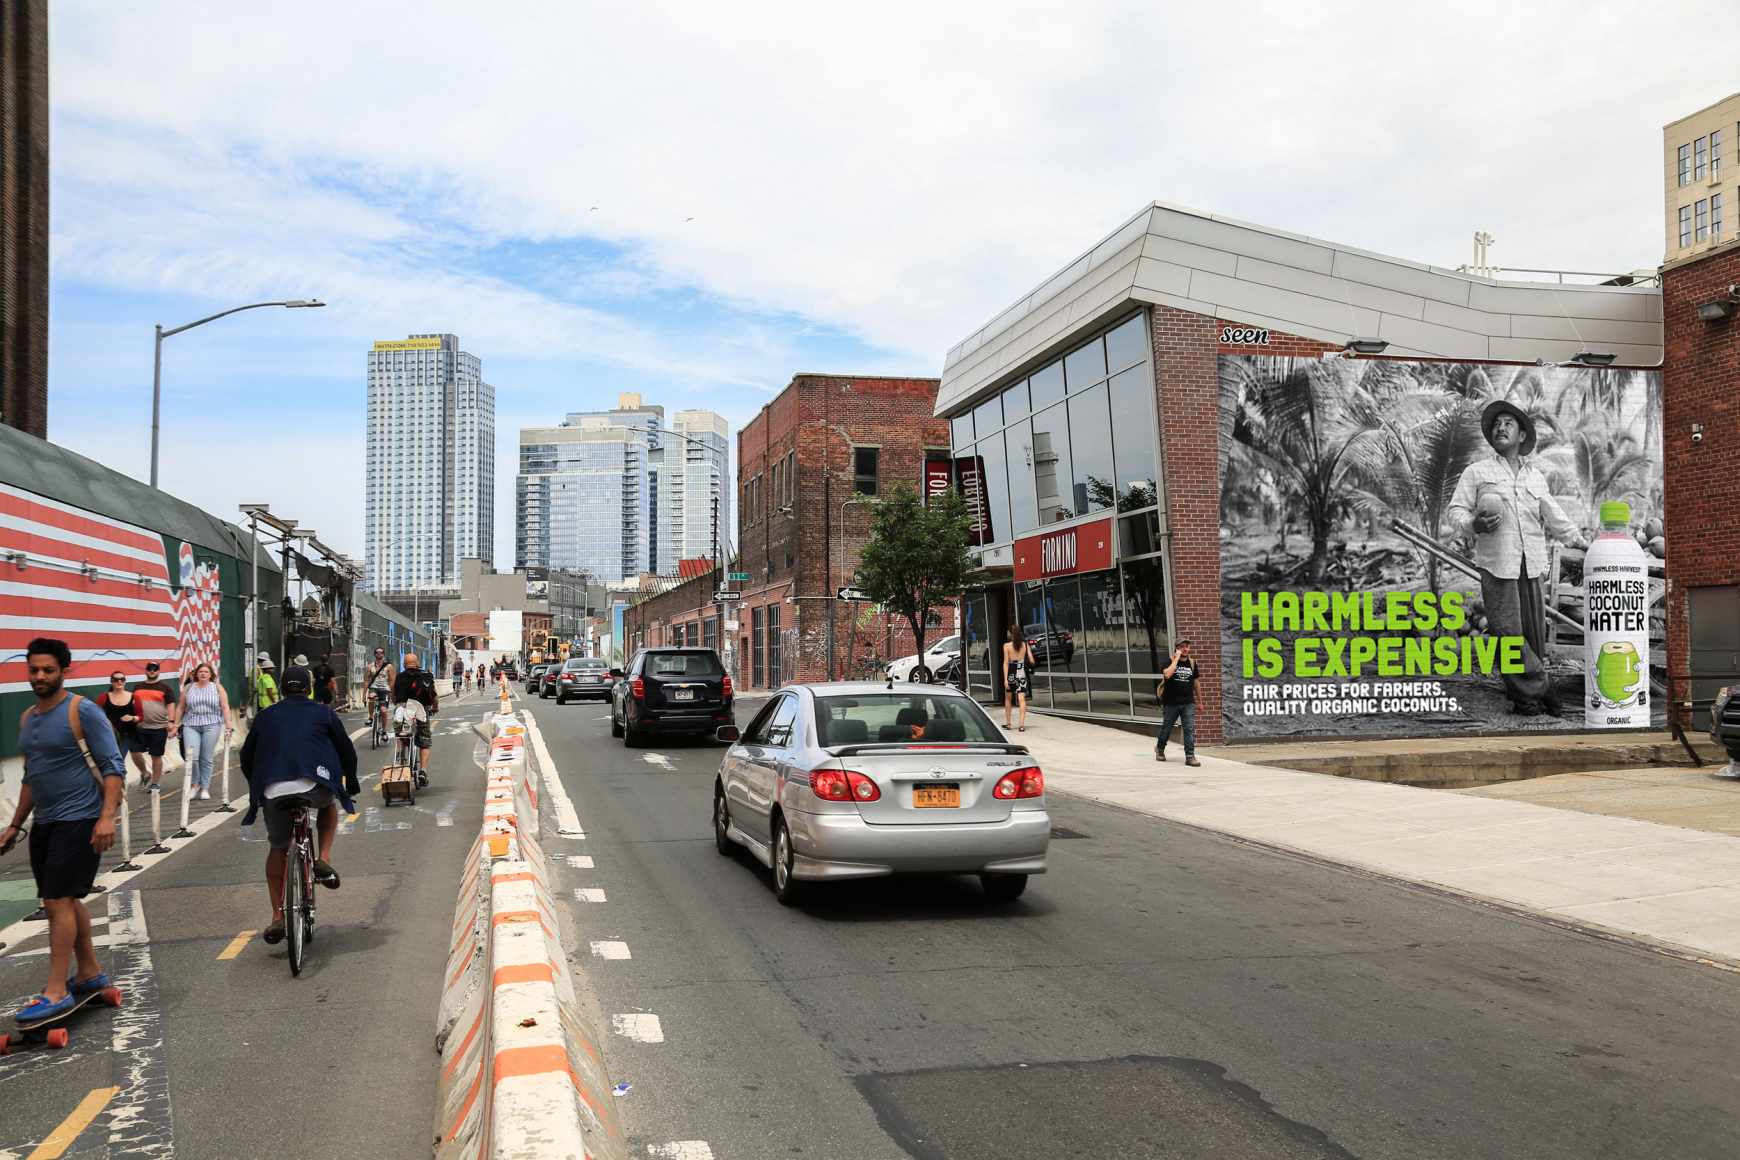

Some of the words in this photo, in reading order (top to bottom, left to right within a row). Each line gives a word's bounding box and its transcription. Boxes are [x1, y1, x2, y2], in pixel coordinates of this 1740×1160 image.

[1220, 327, 1269, 345] seen
[1041, 532, 1077, 574] FORNINO
[1589, 580, 1644, 594] HARMLESS
[1241, 591, 1466, 631] HARMLESS
[1589, 595, 1644, 611] COCONUT
[1589, 612, 1645, 631] WATER
[1242, 637, 1284, 679] IS
[1294, 635, 1526, 678] EXPENSIVE
[1243, 684, 1279, 700] FAIR
[1282, 683, 1337, 699] PRICES
[1341, 682, 1370, 698] FOR
[1373, 681, 1447, 697] FARMERS.
[1243, 700, 1308, 716] QUALITY
[1311, 698, 1378, 714] ORGANIC
[1381, 697, 1463, 713] COCONUTS.
[1606, 716, 1632, 725] ORGANIC
